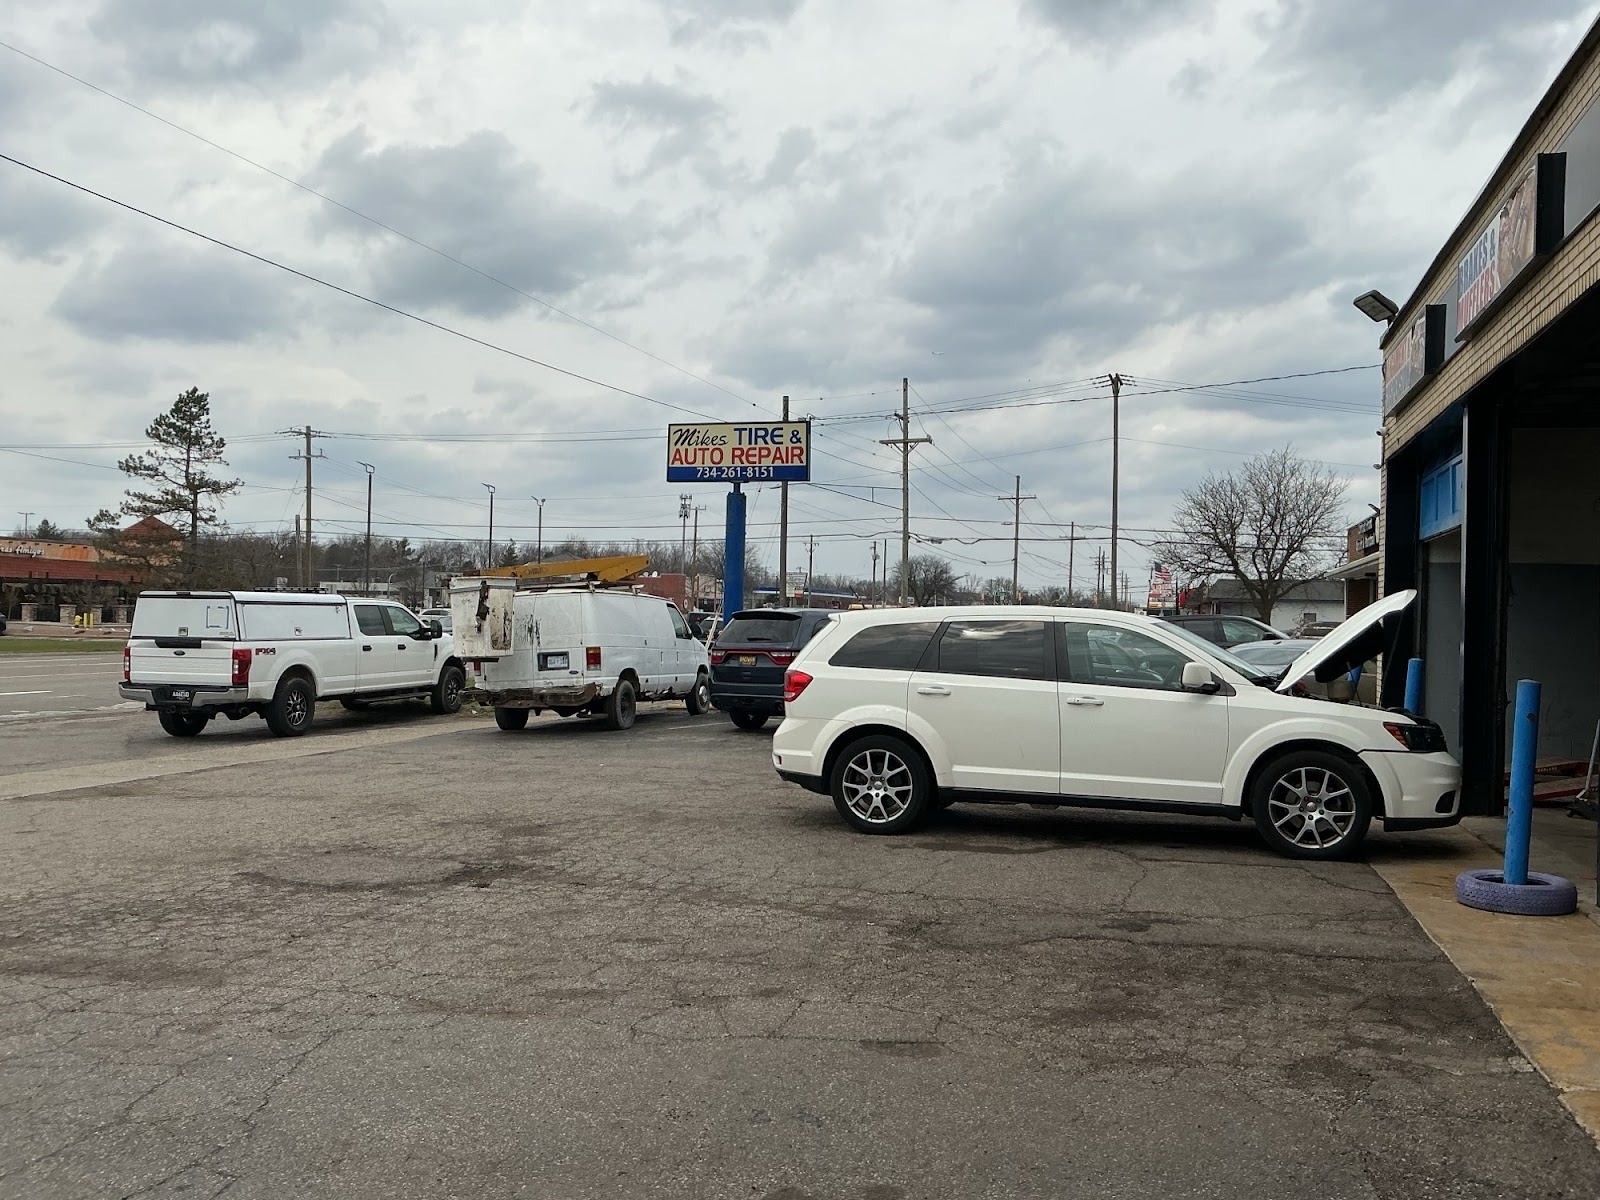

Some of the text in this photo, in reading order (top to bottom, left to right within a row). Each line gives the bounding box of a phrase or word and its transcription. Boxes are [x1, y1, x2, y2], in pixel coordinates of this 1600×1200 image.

[1458, 228, 1496, 299] BRAKES &
[1457, 259, 1496, 335] MUFFLERS
[672, 427, 802, 446] Mikes TIRE &
[671, 446, 804, 465] AUTO REPAIR
[696, 466, 774, 478] 734-261-8151
[255, 647, 276, 656] FX4
